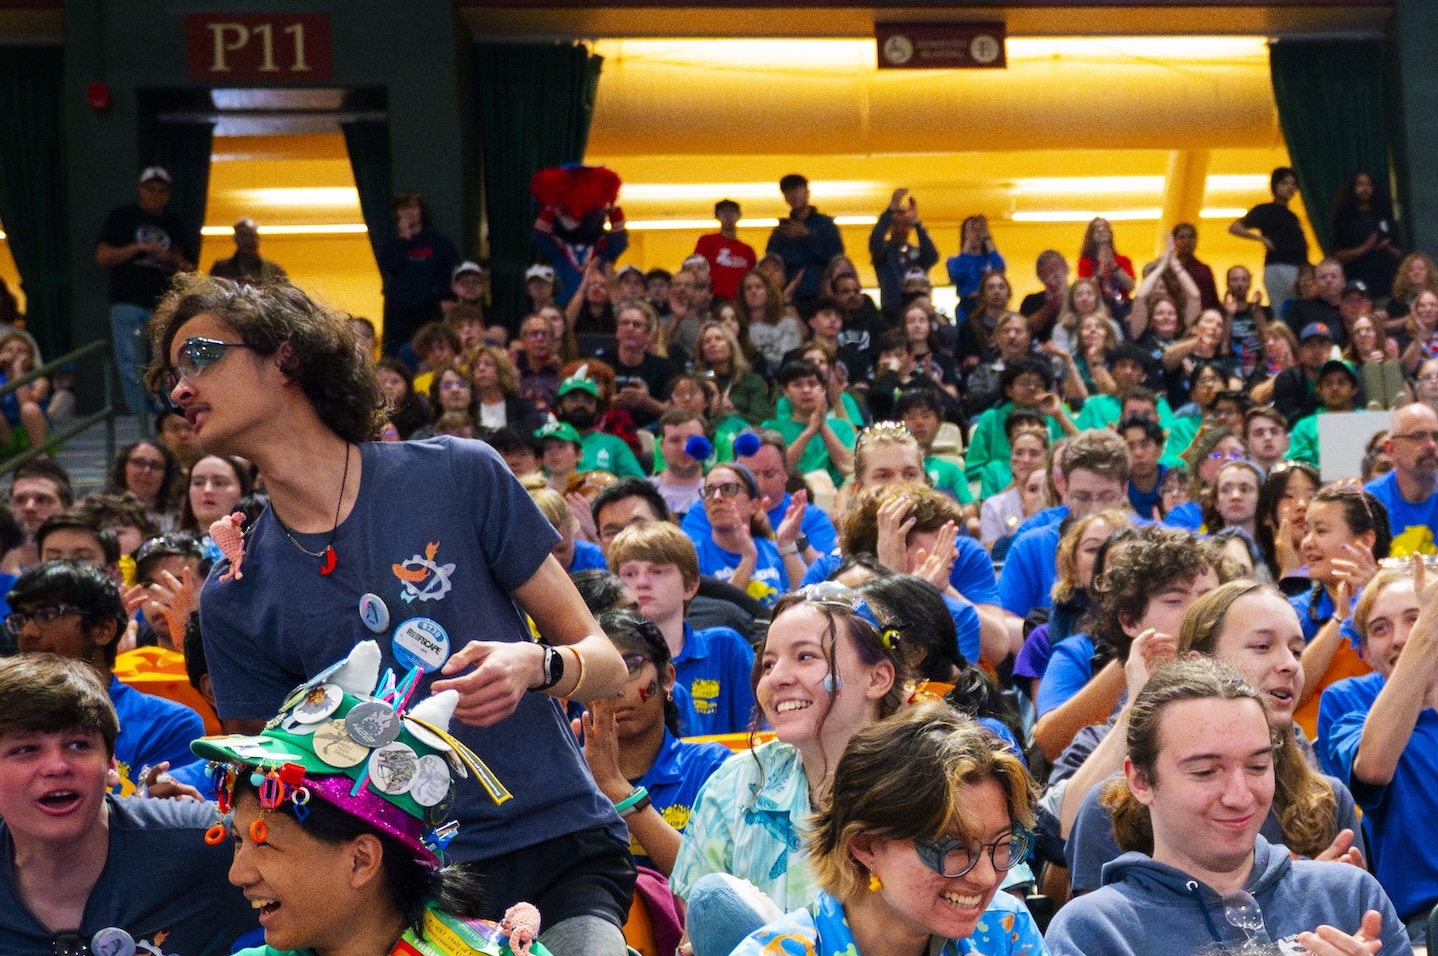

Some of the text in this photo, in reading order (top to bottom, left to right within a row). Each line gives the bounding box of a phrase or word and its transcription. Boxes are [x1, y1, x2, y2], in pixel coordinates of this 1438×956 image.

[206, 21, 312, 72] P11
[405, 627, 443, 655] REEFSCAPE
[351, 722, 376, 743] 422
[447, 935, 461, 948] Hall
[460, 945, 468, 954] of
